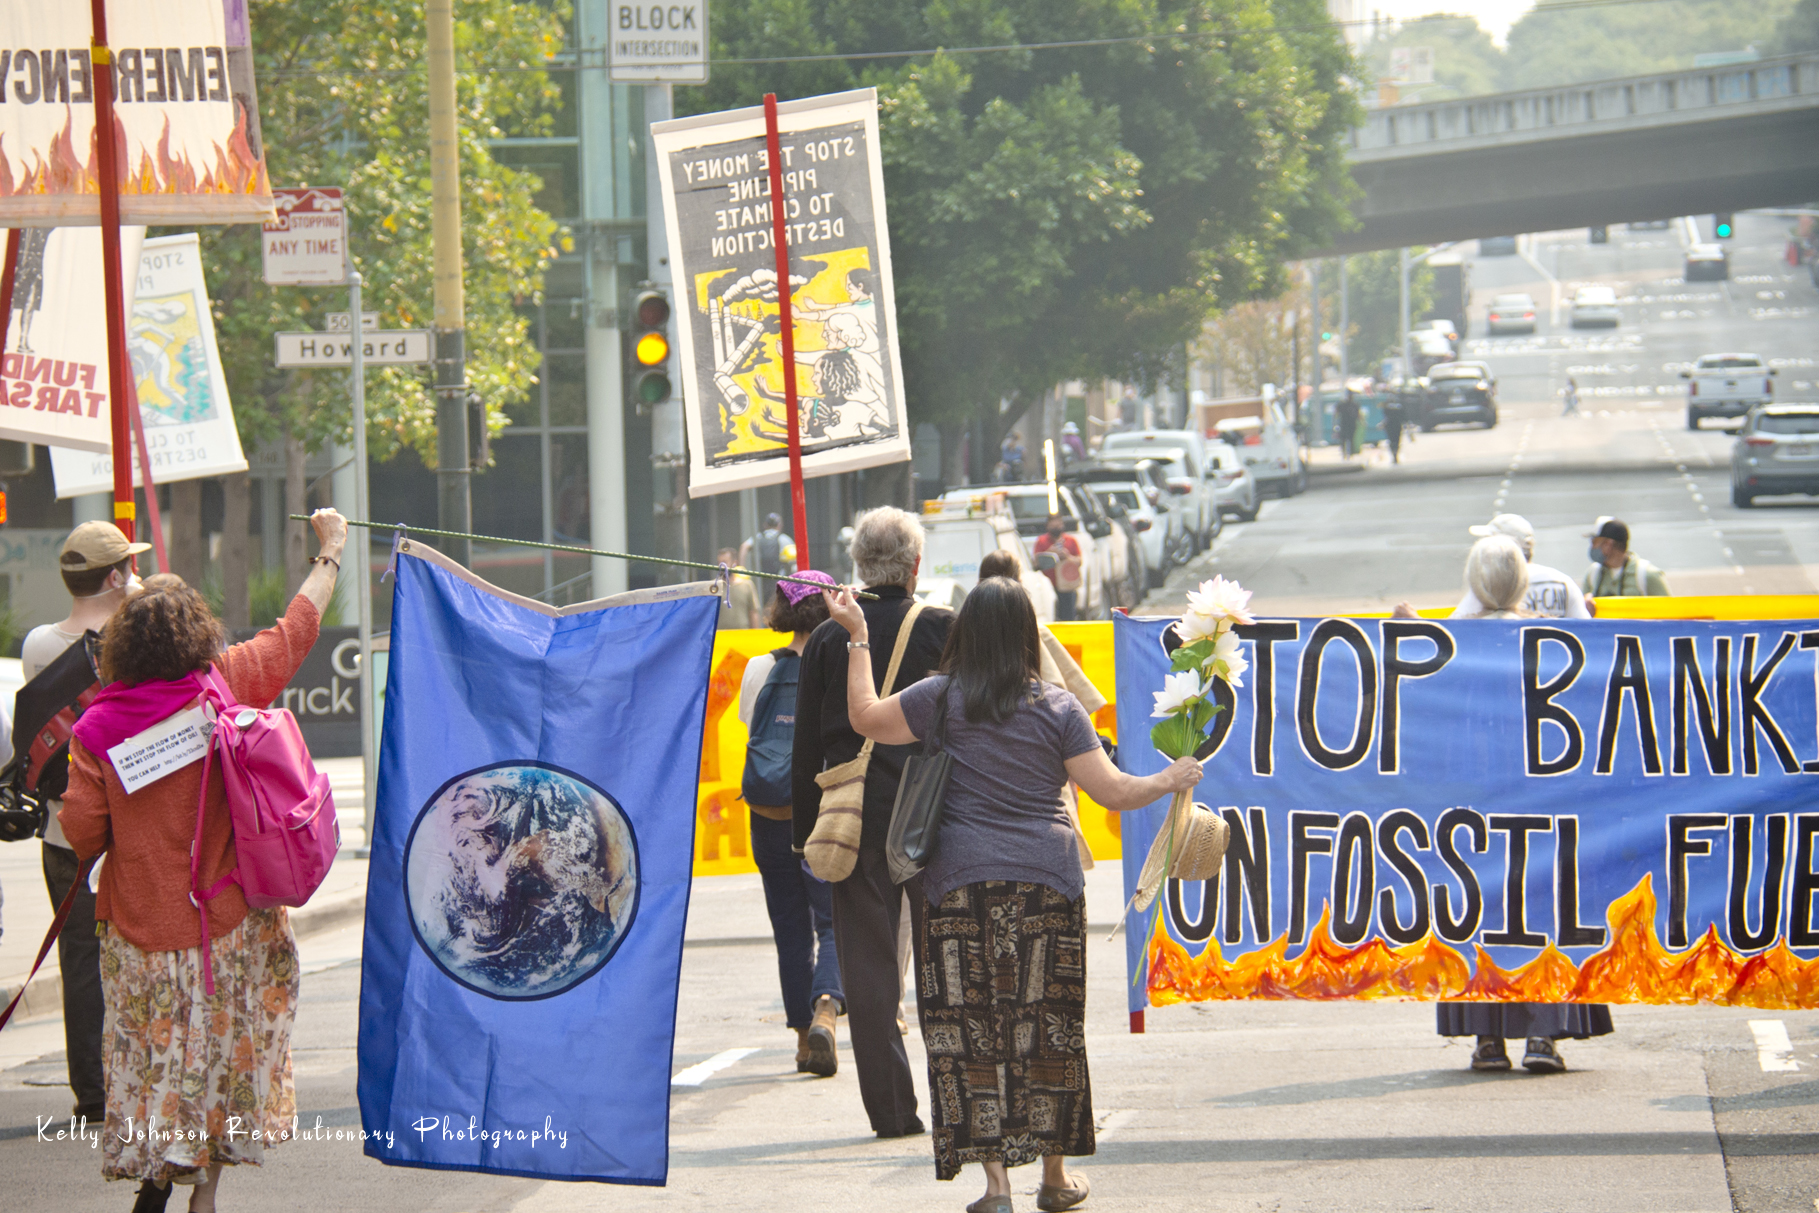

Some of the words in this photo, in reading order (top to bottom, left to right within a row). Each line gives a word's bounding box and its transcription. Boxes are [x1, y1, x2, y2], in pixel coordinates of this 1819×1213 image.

[618, 5, 696, 30] BLOCK
[615, 40, 699, 56] INTERSECTION
[291, 215, 340, 228] STOPPING
[269, 240, 298, 255] ANY
[304, 239, 338, 254] TIME
[331, 316, 350, 328] 50
[301, 338, 406, 357] Howard
[132, 749, 146, 758] STOP
[145, 744, 155, 752] THE
[155, 737, 169, 747] FLOW
[177, 725, 194, 737] MONEY
[122, 762, 135, 771] THEN
[143, 751, 156, 761] STOP
[165, 740, 180, 750] FLOW
[127, 774, 139, 783] YOU
[138, 769, 149, 778] CAN
[149, 763, 161, 772] HELP
[1287, 806, 1607, 949] FOSSIL
